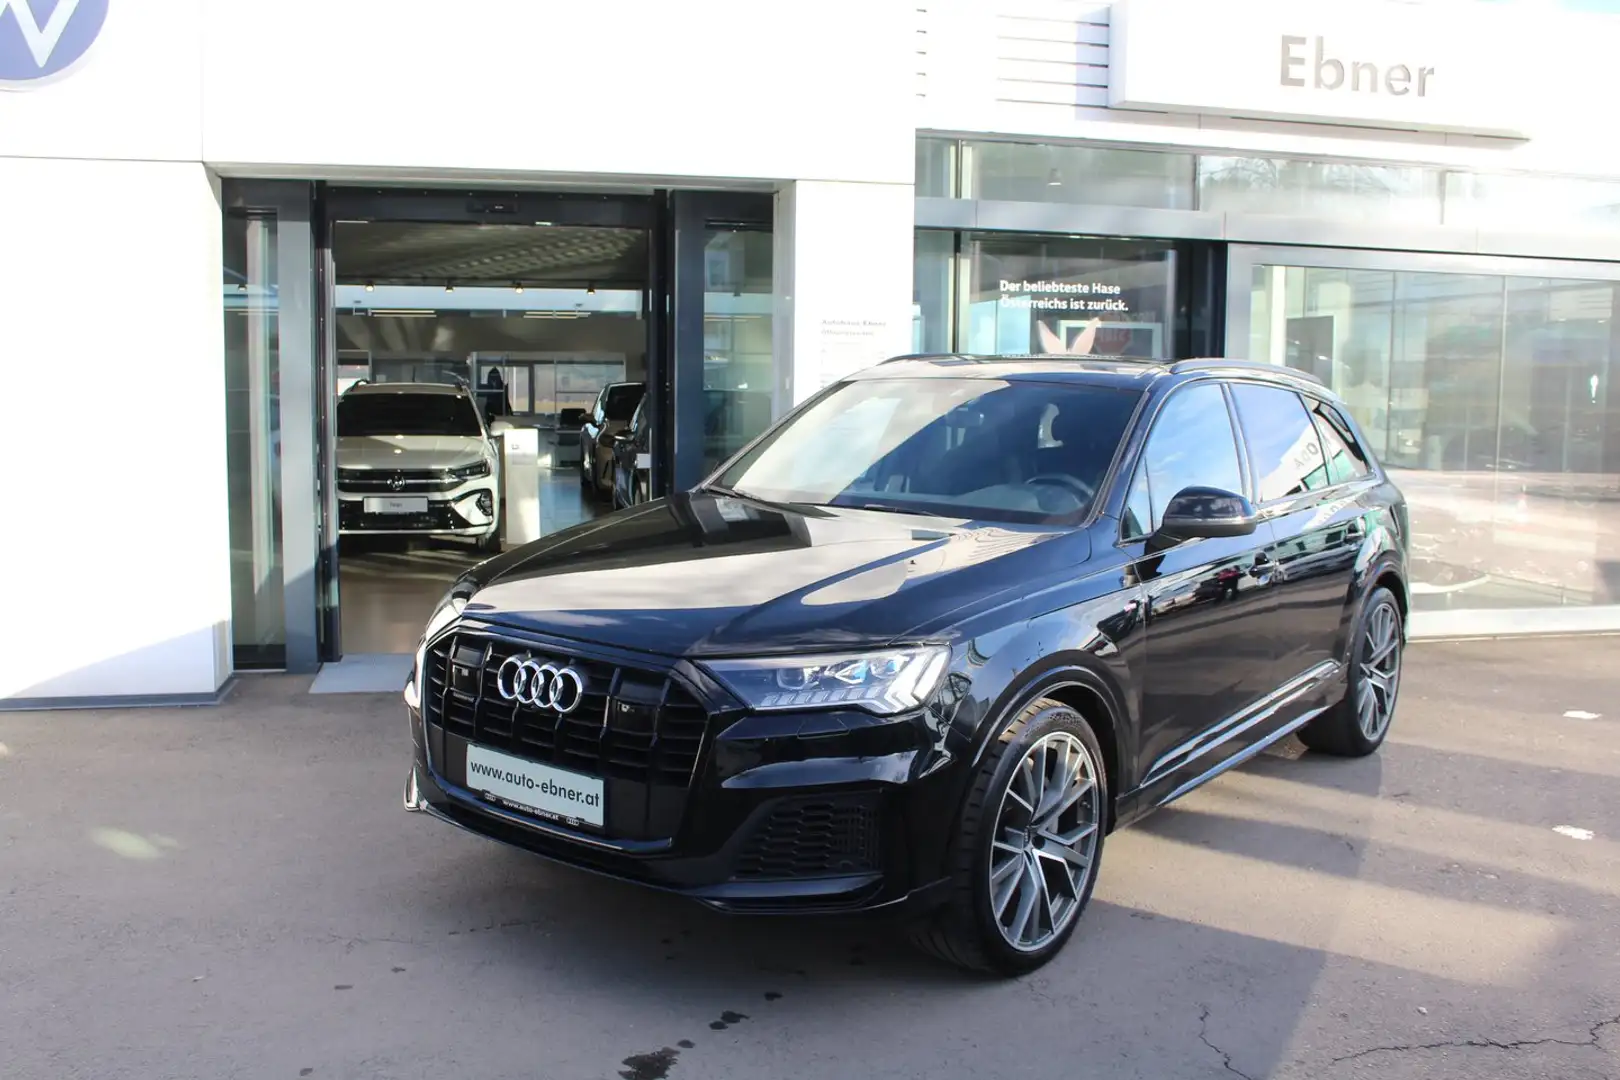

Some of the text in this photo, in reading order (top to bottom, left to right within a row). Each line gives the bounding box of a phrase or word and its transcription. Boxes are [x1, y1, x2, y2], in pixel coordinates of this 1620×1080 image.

[1280, 34, 1435, 97] Ebner
[1000, 280, 1121, 294] Der beliebteste Hase
[1001, 294, 1129, 311] Österreichs ist zurück.
[470, 761, 600, 808] www.auto-ebner.at
